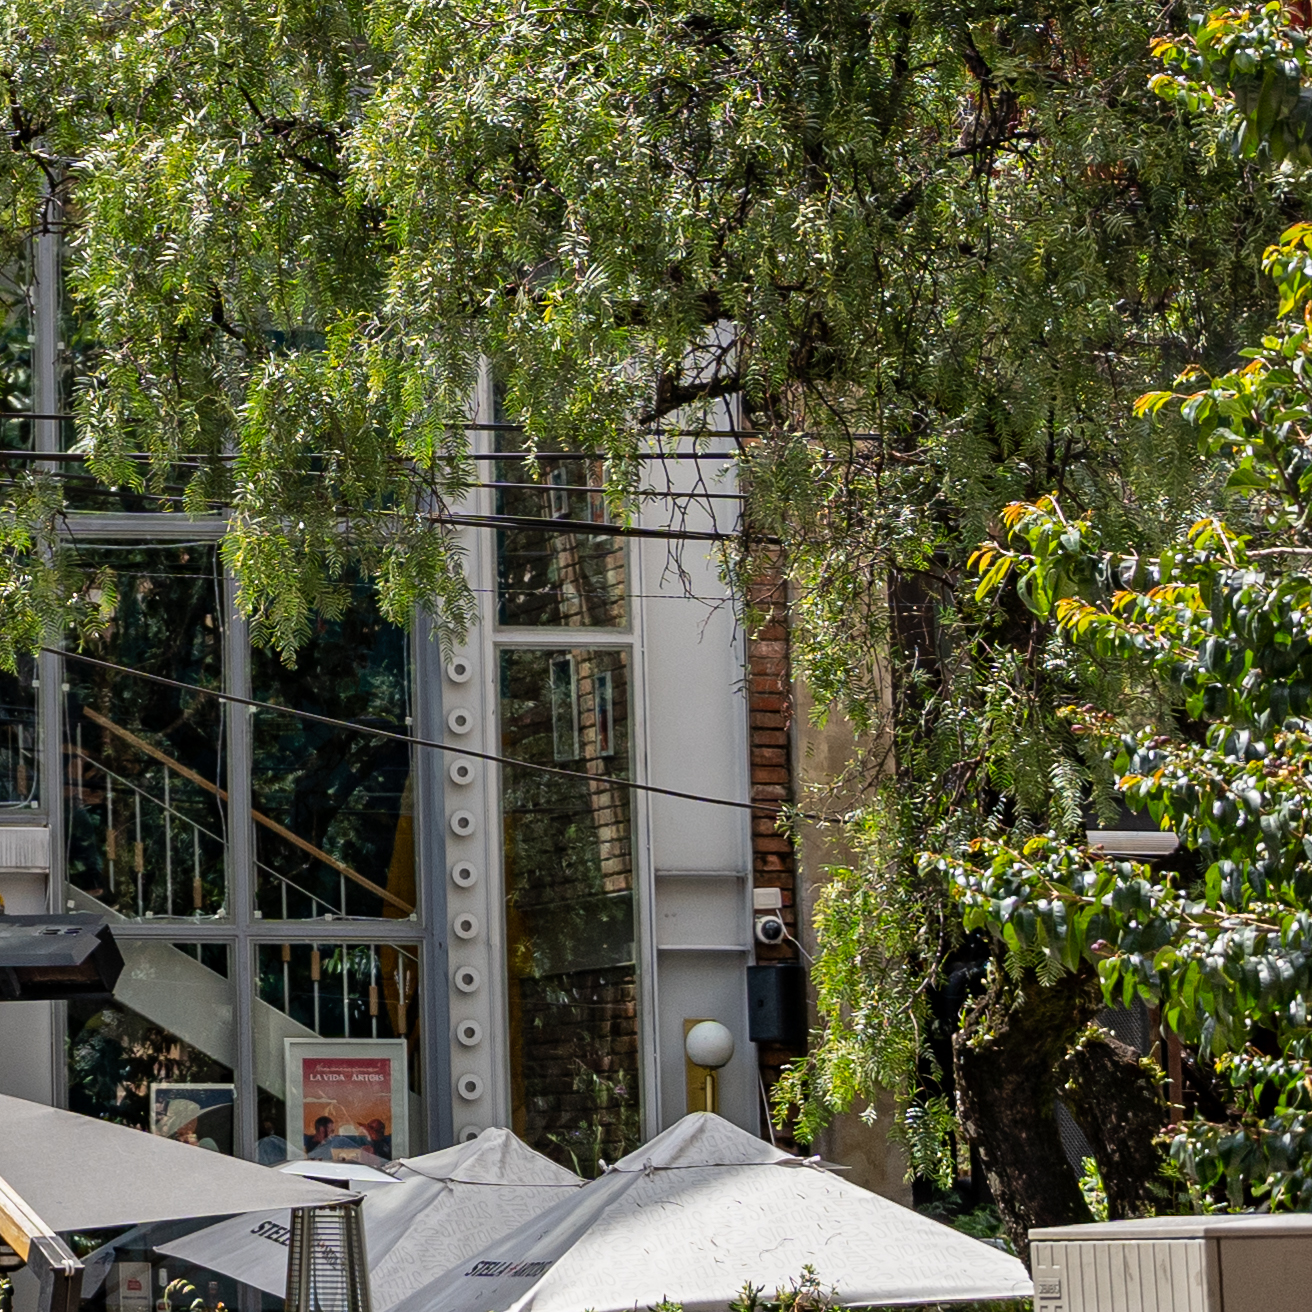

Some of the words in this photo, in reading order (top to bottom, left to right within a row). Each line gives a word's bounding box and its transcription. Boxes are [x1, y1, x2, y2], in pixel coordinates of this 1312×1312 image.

[352, 1074, 384, 1082] ARTOIS
[250, 1220, 290, 1246] STELL
[464, 1259, 514, 1277] STELLA
